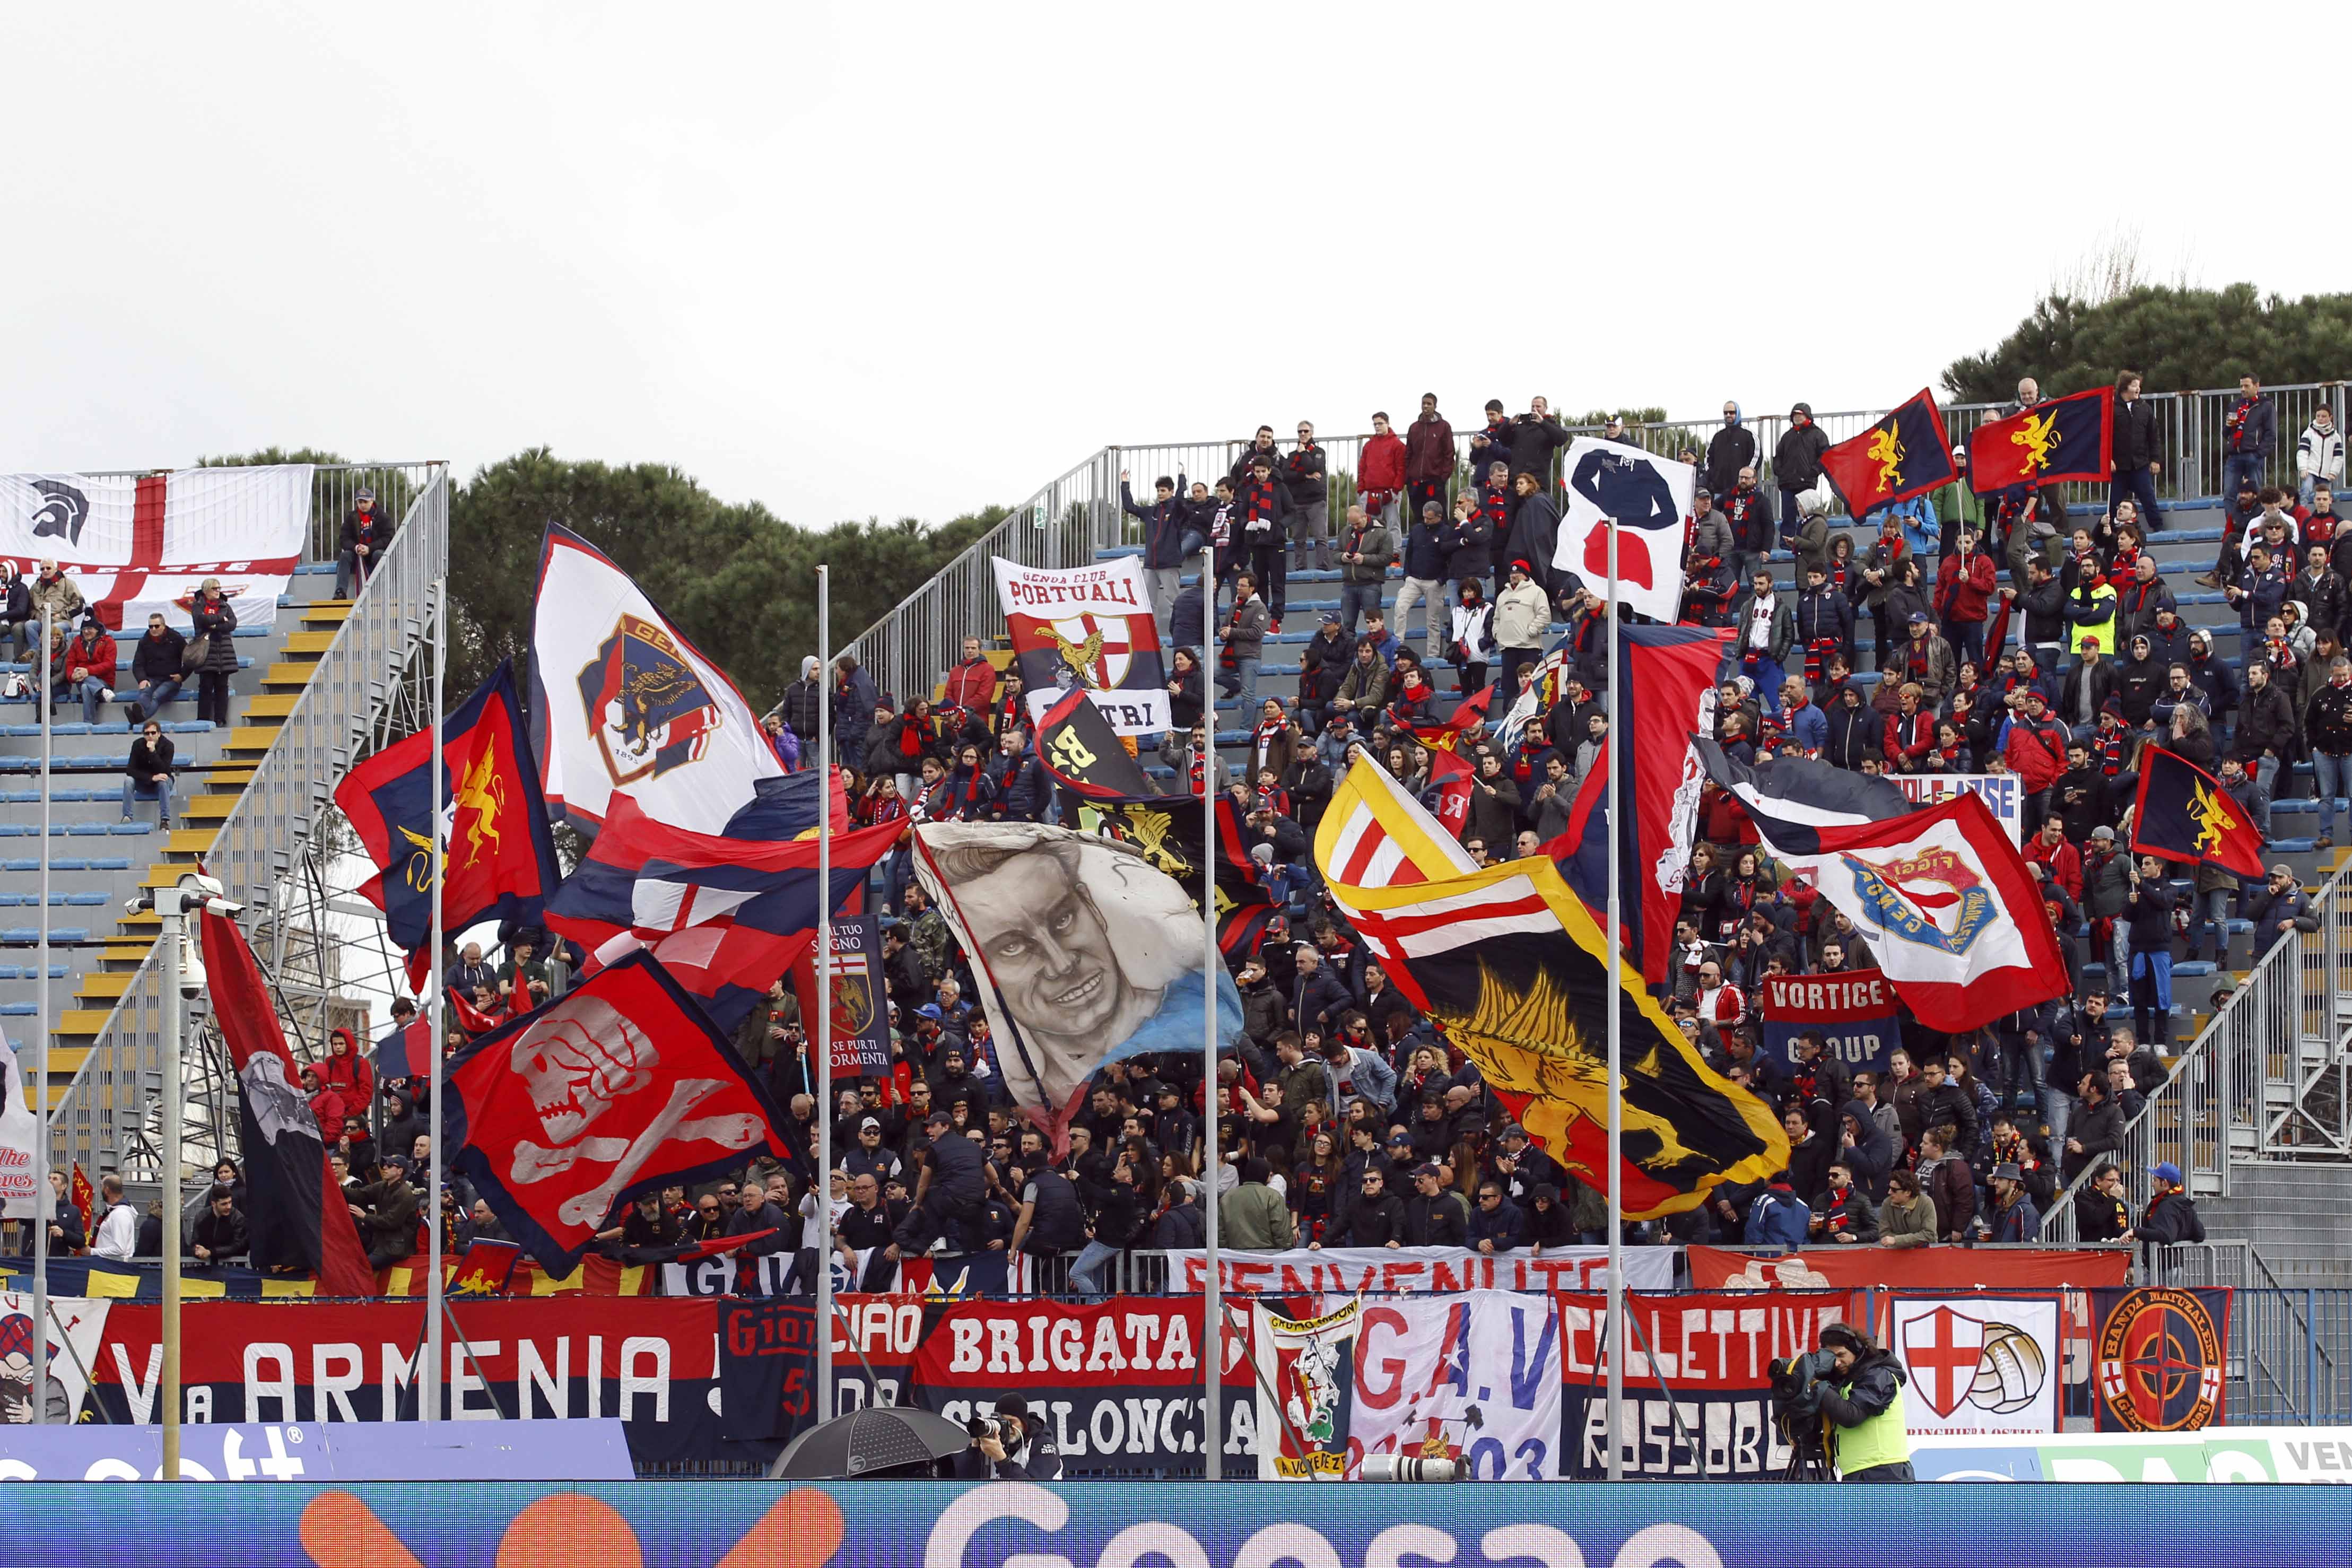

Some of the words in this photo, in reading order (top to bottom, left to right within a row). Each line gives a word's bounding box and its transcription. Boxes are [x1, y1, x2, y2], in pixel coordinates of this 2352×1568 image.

[1074, 570, 1107, 583] CLUB
[1008, 578, 1138, 606] PORTUALI
[840, 924, 863, 935] TUO
[811, 937, 861, 952] SGNO
[1771, 980, 1884, 1010] VORTICE
[830, 1052, 888, 1067] ORMENTA
[832, 1041, 844, 1052] SE
[847, 1040, 868, 1050] PUR
[868, 1039, 877, 1050] TI
[1787, 1034, 1880, 1064] GOUP
[2105, 1297, 2144, 1356] BANDA
[949, 1313, 1196, 1374] BRIGATA
[243, 1336, 670, 1423] ARMENIA
